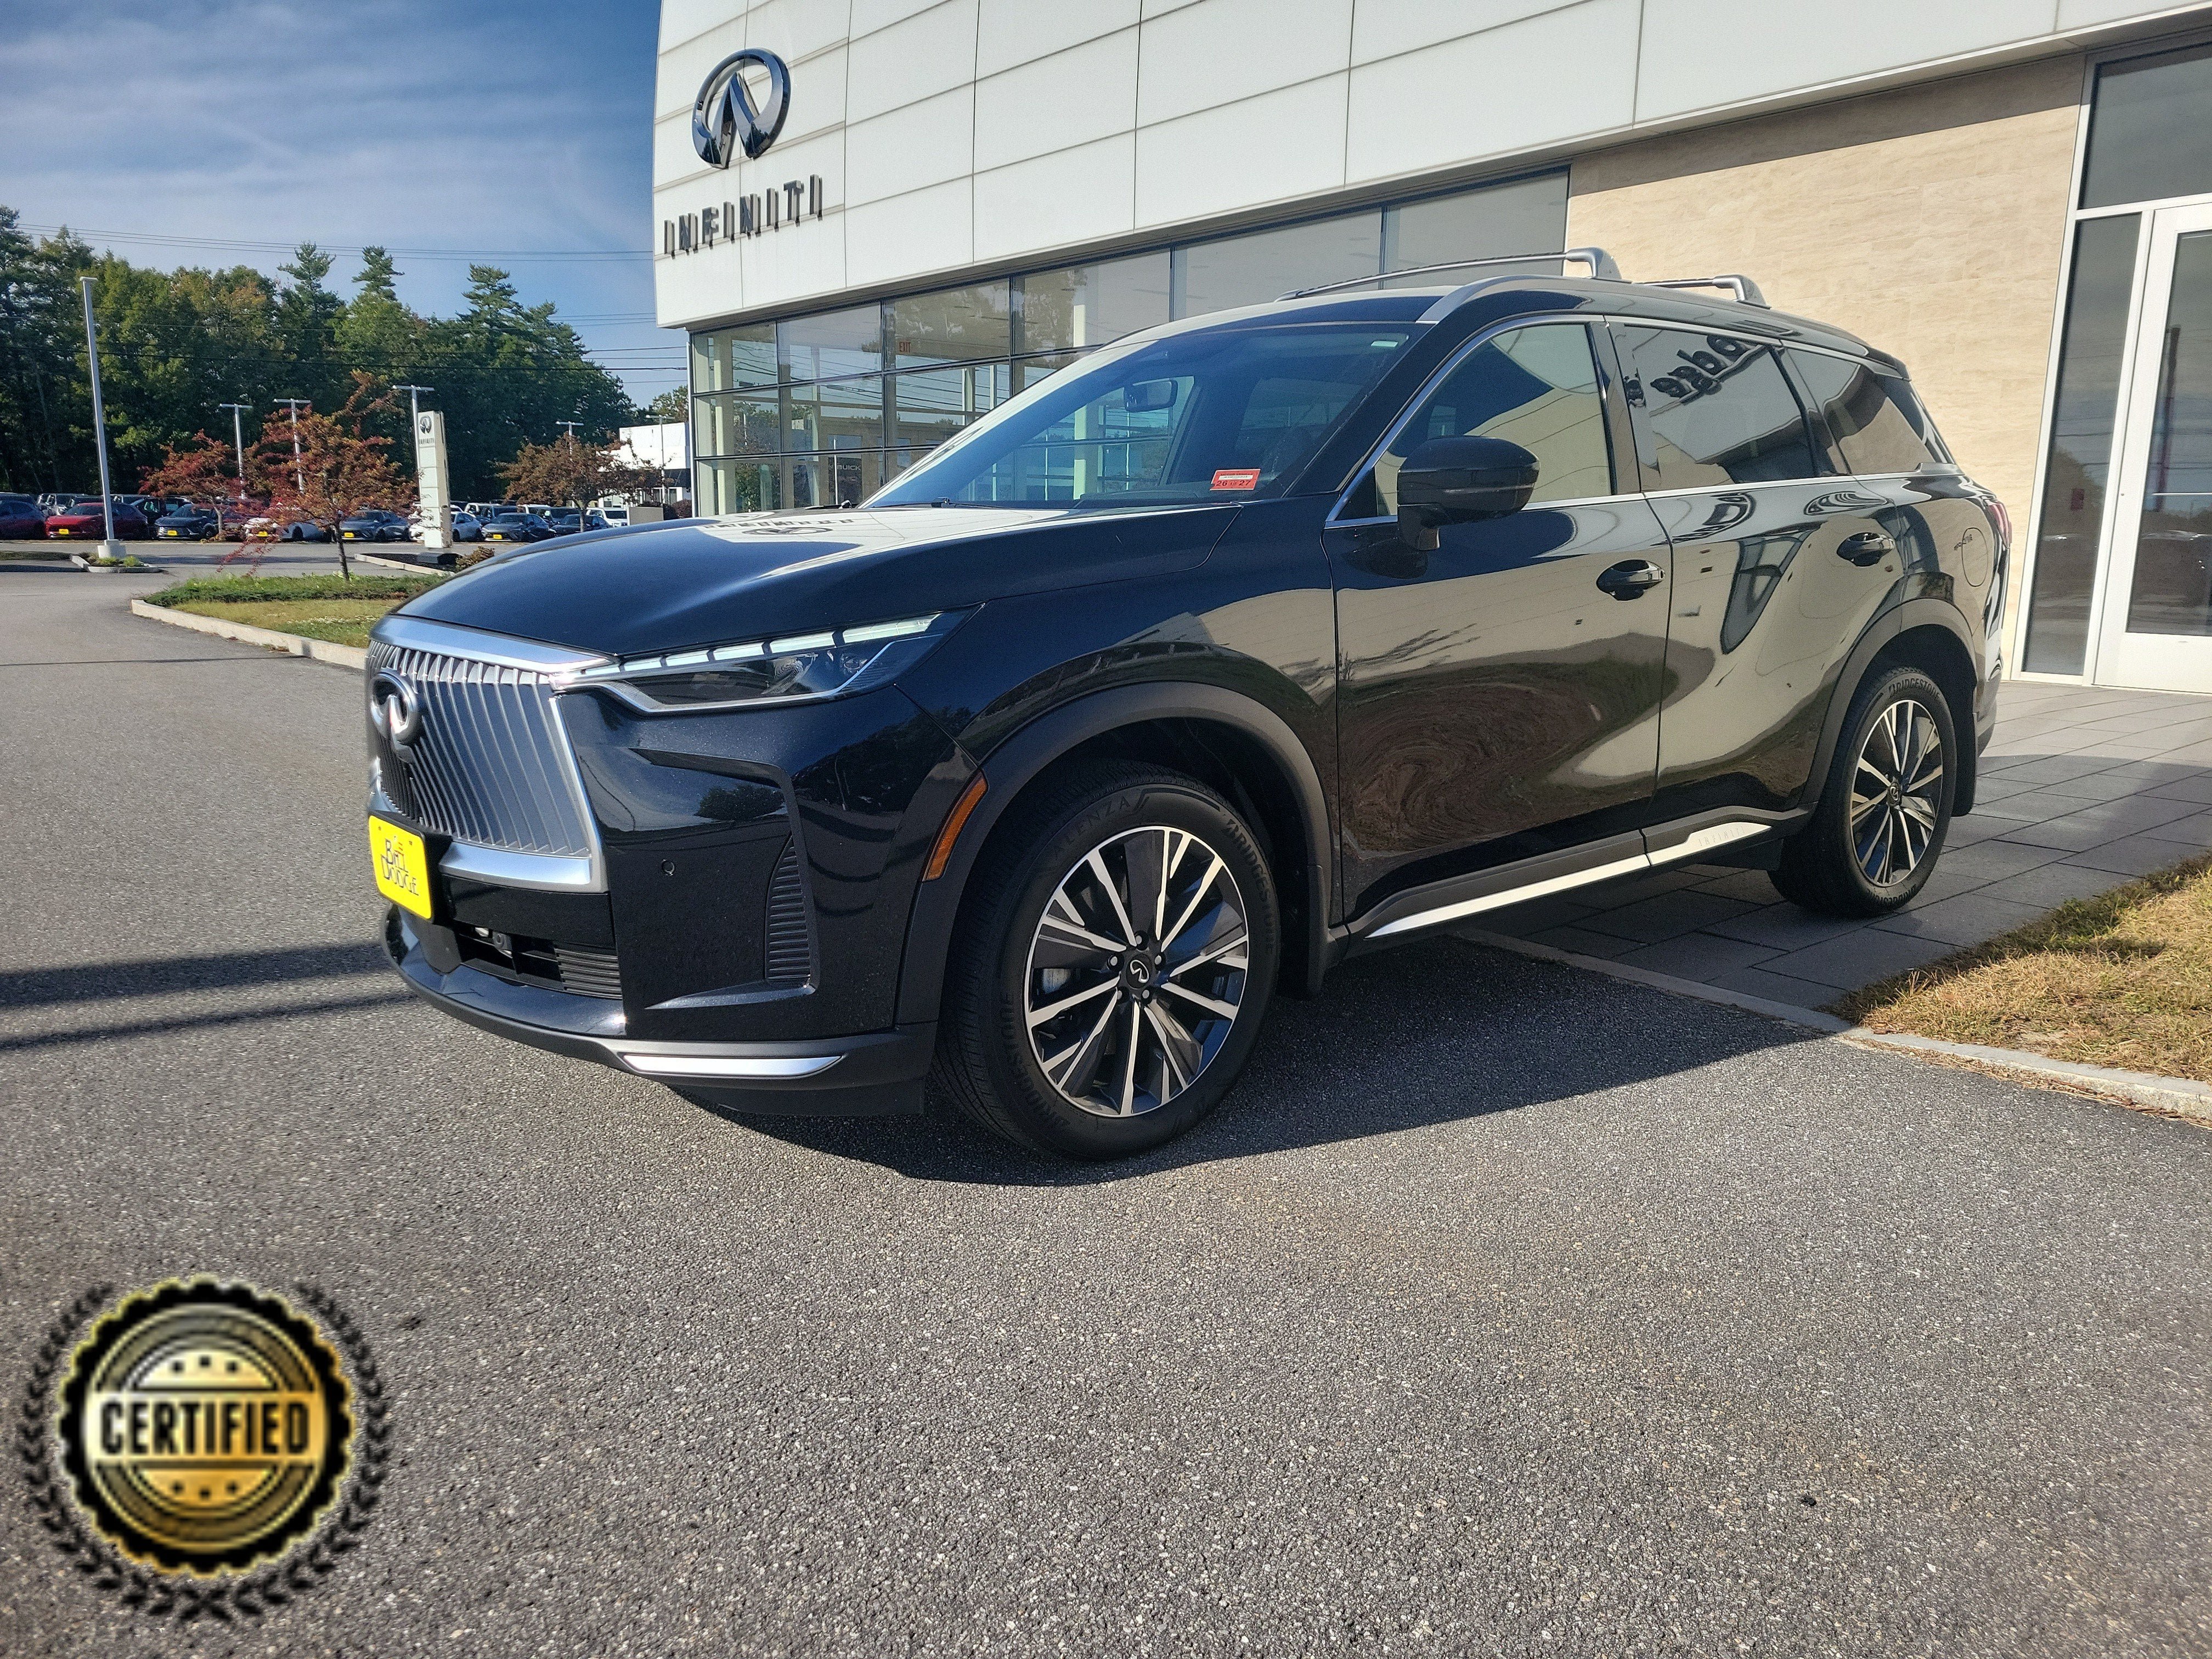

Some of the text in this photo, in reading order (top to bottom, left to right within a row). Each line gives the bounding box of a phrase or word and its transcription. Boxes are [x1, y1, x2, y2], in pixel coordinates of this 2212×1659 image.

[664, 174, 822, 258] INFINITI
[899, 341, 911, 353] EXIT
[1889, 678, 1940, 698] BRIDGESTONE
[1053, 796, 1131, 858] ALENZA
